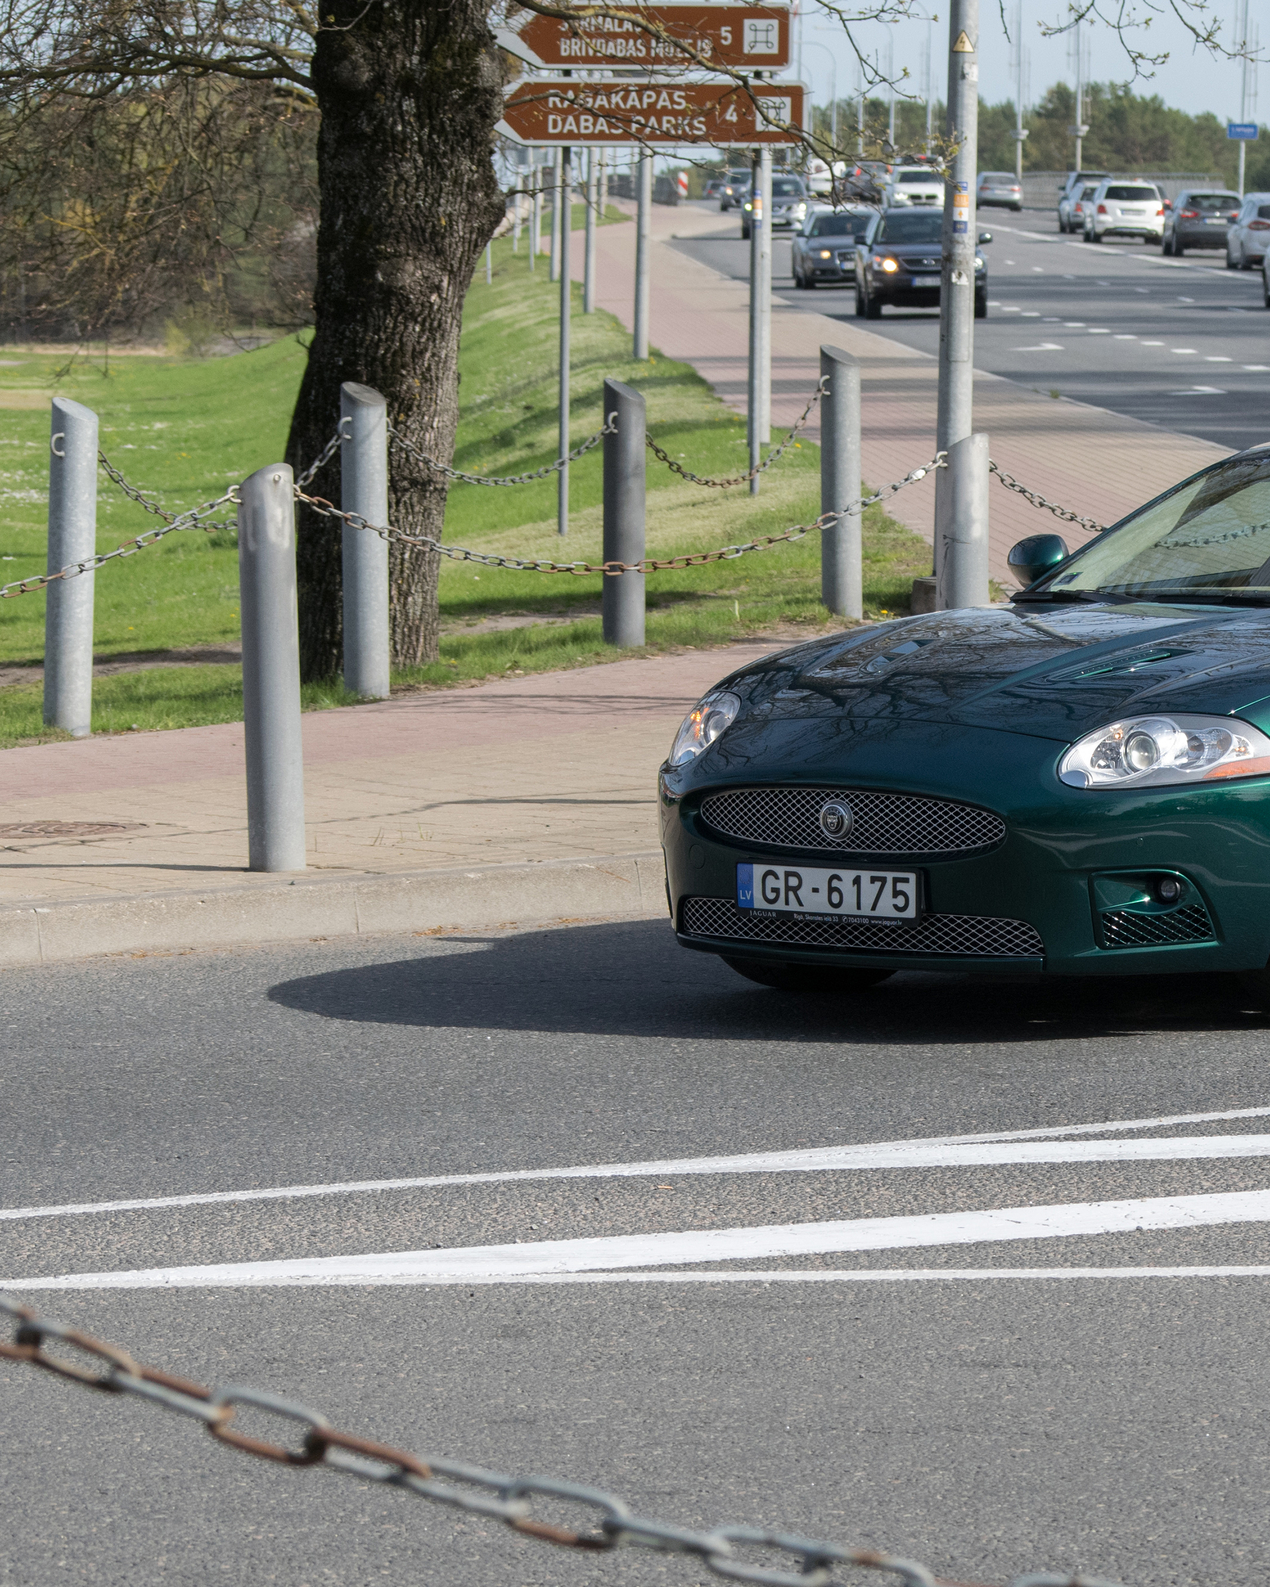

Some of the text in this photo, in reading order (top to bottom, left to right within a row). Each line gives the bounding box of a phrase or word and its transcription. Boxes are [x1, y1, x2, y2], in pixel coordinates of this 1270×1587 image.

[720, 26, 732, 45] 5
[725, 104, 738, 123] 4
[547, 114, 707, 136] DABAS PARKS
[739, 869, 910, 913] LV GR-6175
[750, 909, 777, 918] JAGUAR
